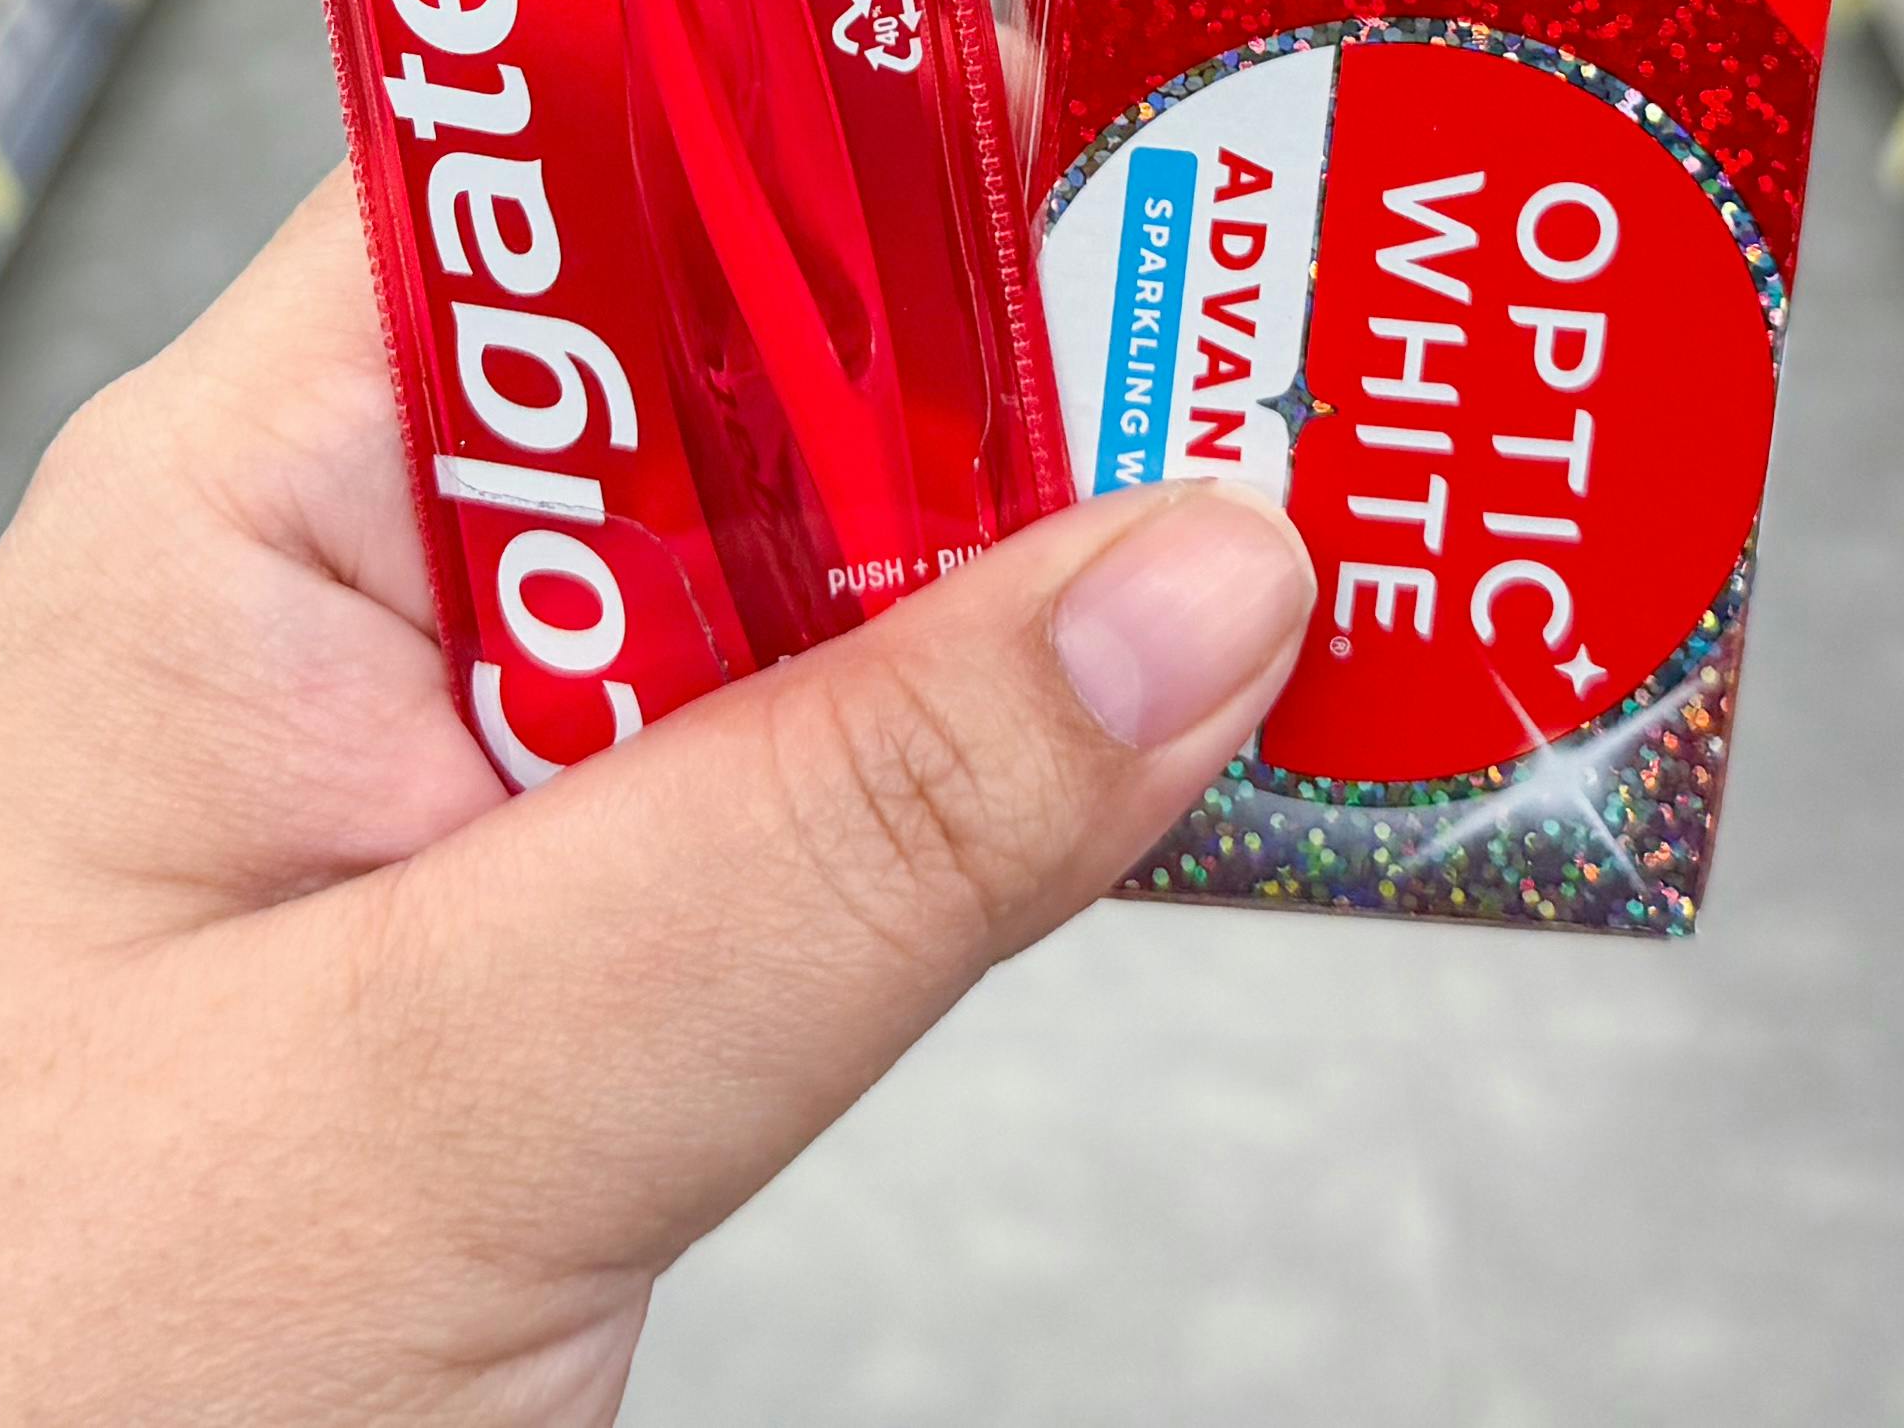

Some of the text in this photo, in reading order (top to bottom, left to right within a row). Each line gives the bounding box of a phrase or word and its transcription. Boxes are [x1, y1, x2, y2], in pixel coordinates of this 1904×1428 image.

[1118, 197, 1173, 438] SPARKLING
[1470, 180, 1621, 649] OPTIC
[828, 557, 905, 598] PUSH
